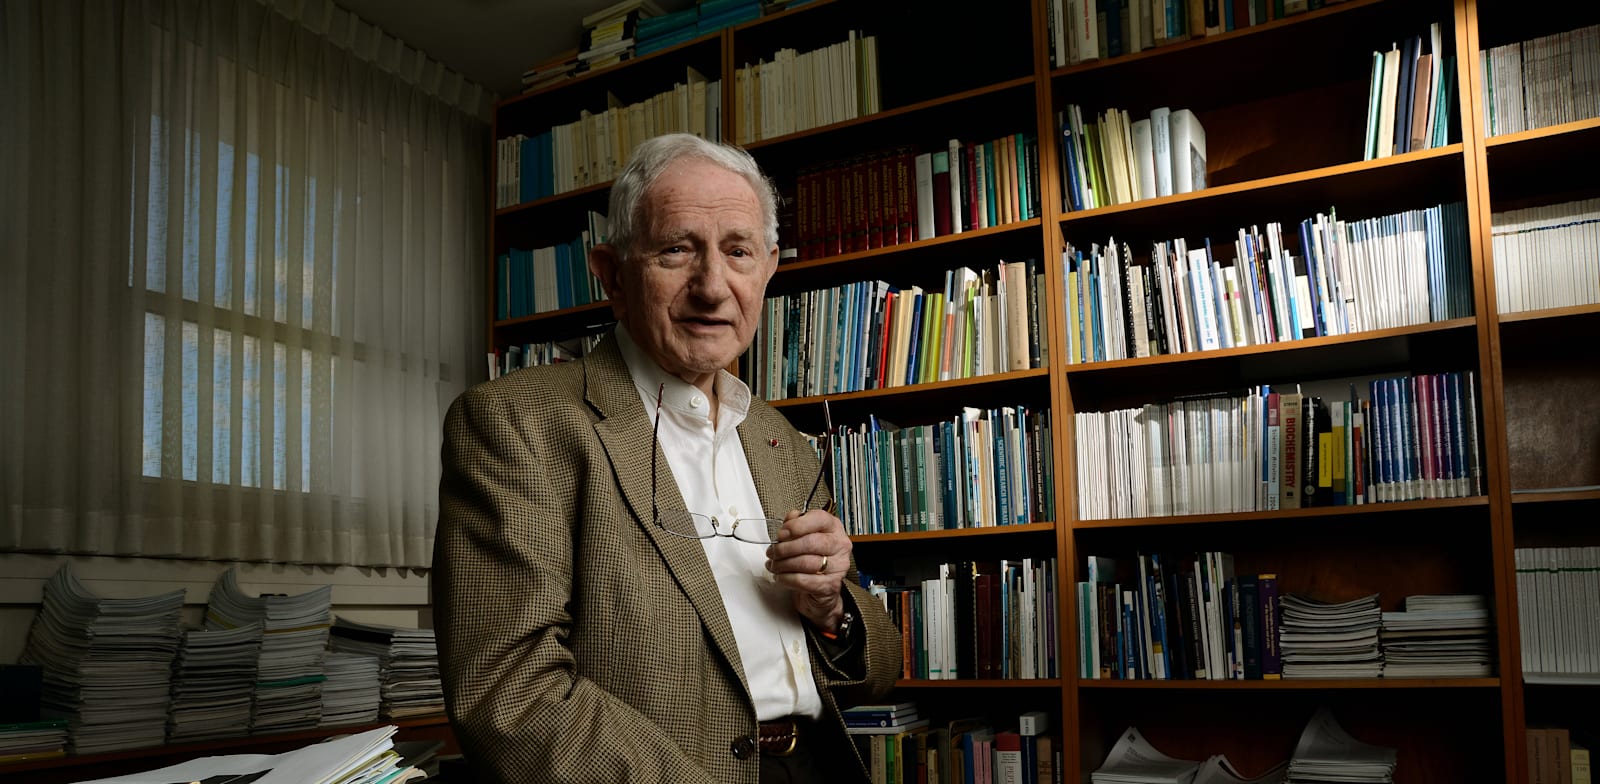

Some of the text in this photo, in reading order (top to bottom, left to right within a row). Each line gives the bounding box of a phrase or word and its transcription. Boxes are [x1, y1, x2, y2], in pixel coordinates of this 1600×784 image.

[998, 439, 1006, 468] SCIENTIFIC
[1286, 418, 1296, 489] BIOCHEMISTRY
[1000, 468, 1008, 497] RESEARCH
